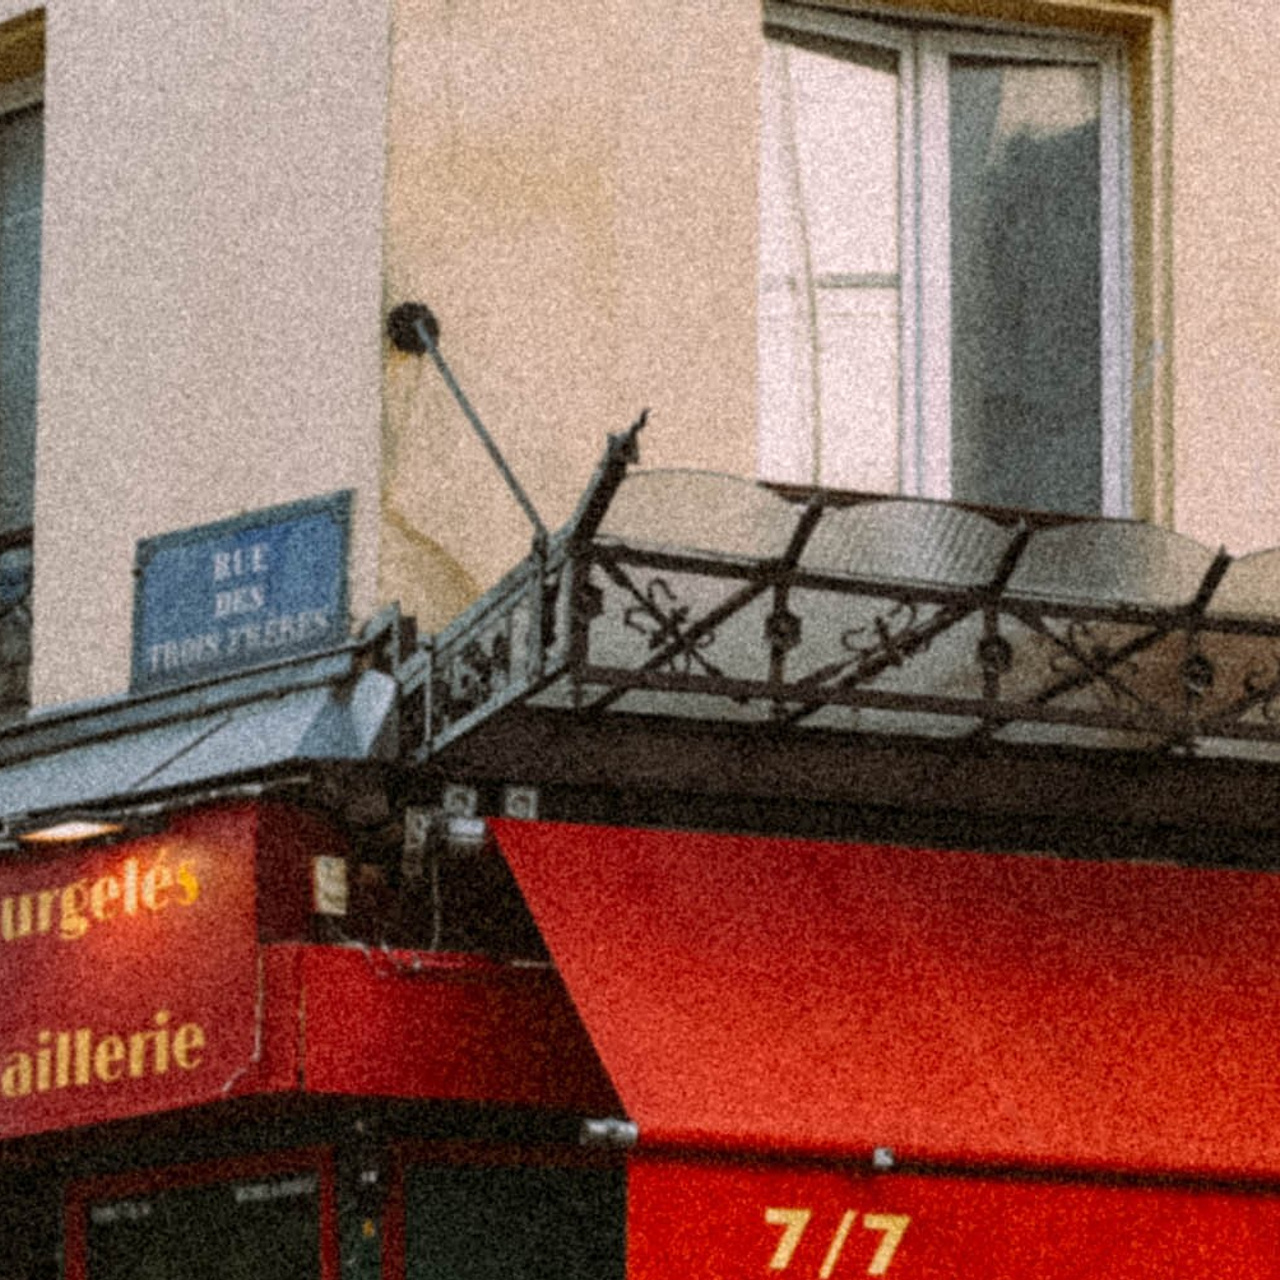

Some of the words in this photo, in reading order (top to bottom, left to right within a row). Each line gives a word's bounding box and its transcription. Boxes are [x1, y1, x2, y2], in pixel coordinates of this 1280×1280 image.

[213, 542, 269, 582] RUE
[215, 582, 266, 618] DES
[1, 1008, 206, 1098] aillerie
[764, 1207, 912, 1280] 7/7
